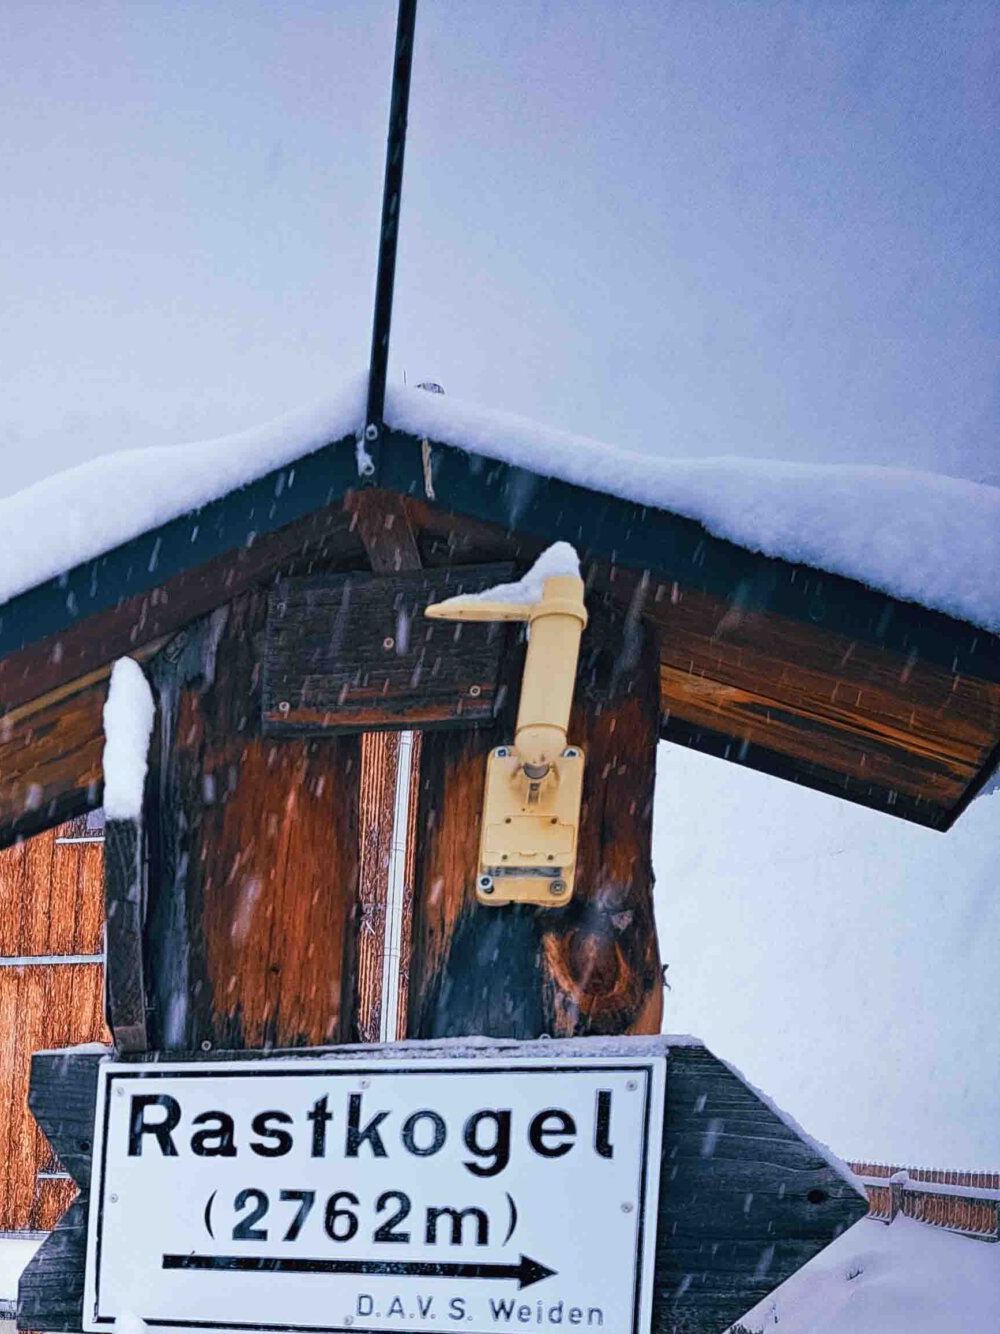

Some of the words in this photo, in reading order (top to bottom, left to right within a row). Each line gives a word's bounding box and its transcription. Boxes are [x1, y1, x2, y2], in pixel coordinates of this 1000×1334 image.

[126, 1088, 615, 1177] Rastkogel
[203, 1186, 519, 1246] (2762m)
[356, 1294, 436, 1320] D.A.V.
[447, 1298, 473, 1321] S.
[488, 1299, 604, 1326] Weiden
